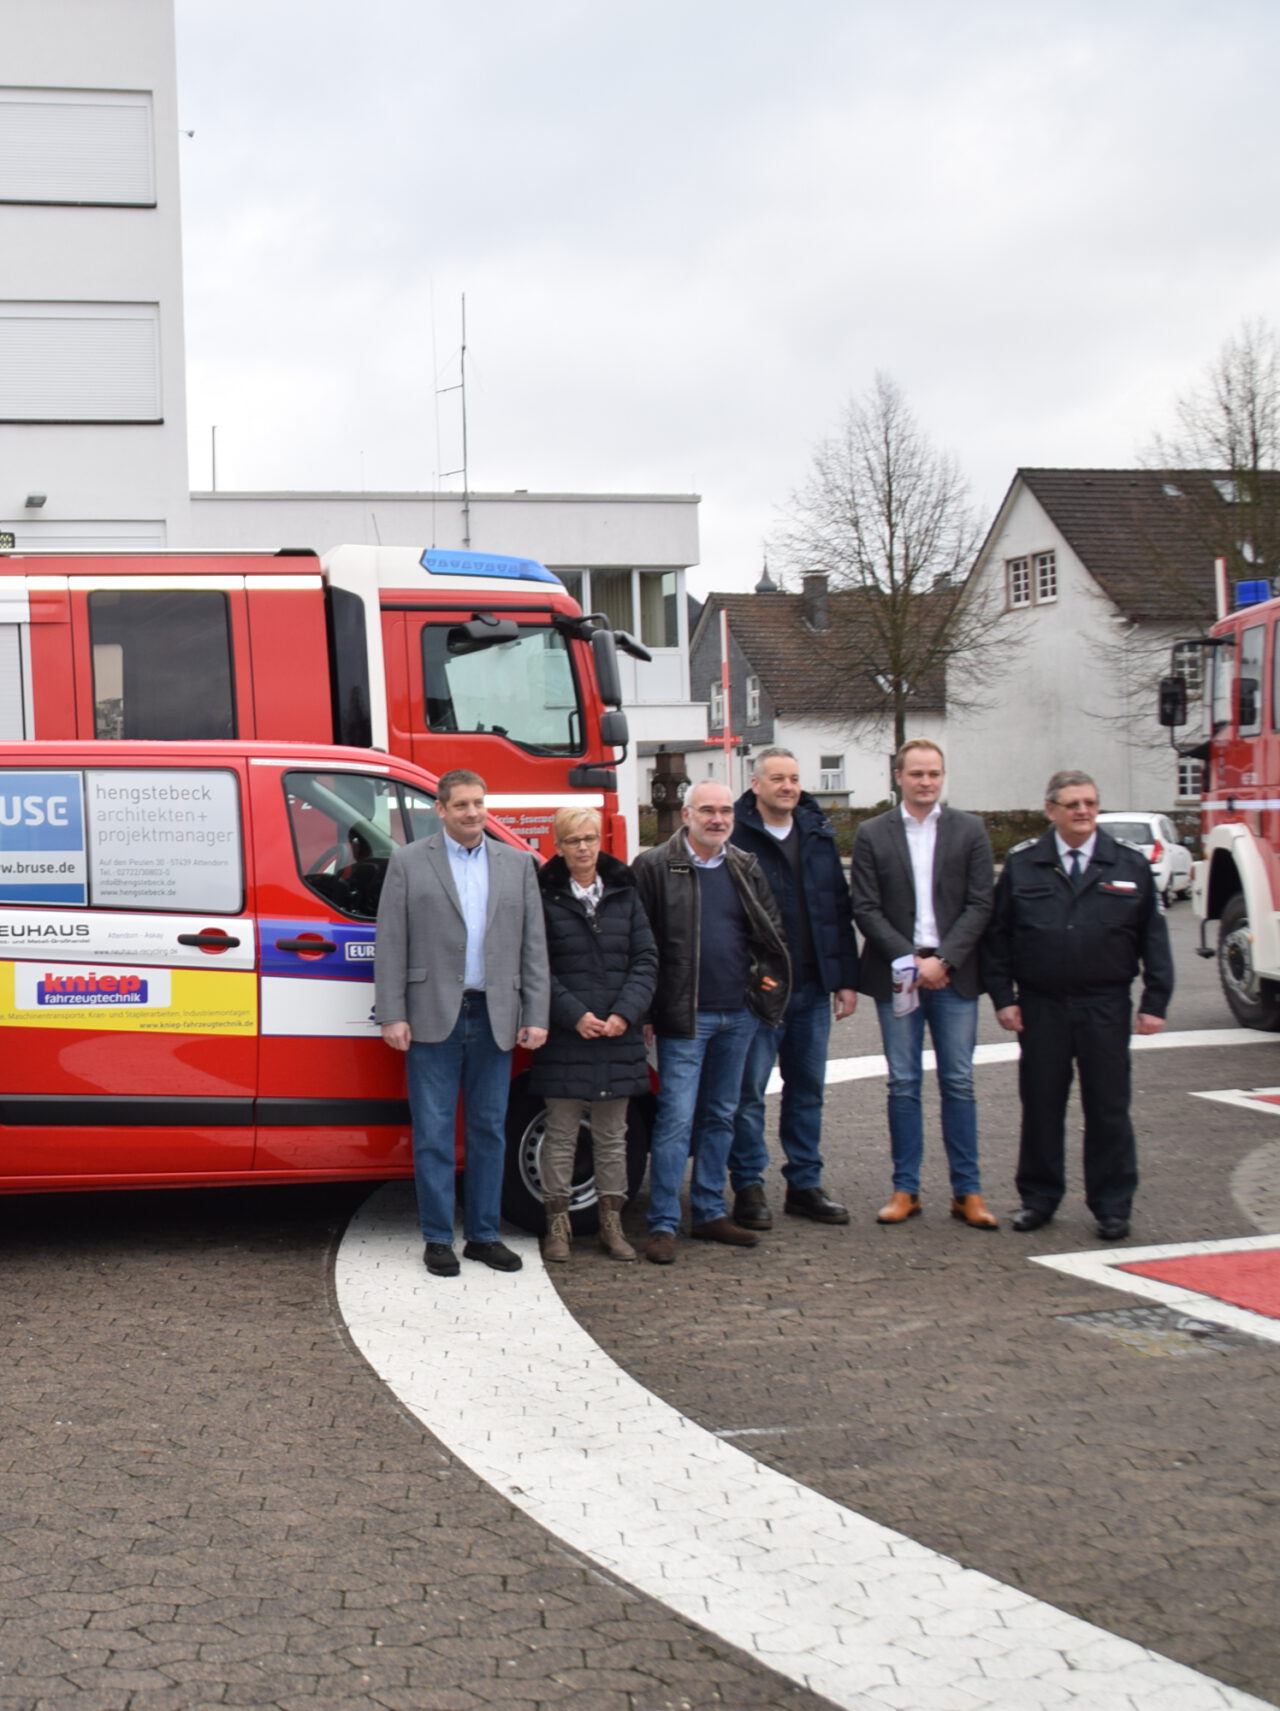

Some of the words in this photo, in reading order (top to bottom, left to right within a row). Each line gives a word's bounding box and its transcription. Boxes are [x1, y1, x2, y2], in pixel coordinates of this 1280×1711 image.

[96, 784, 212, 804] hengstebeck
[98, 827, 234, 846] projektmanager
[100, 888, 176, 897] www.hengstebeck.de
[349, 945, 375, 957] EUR
[44, 972, 141, 994] kniep
[44, 993, 141, 1004] fahrzeugtechnik
[139, 1020, 254, 1029] www.kniep-fahrzeugtechnik.de
